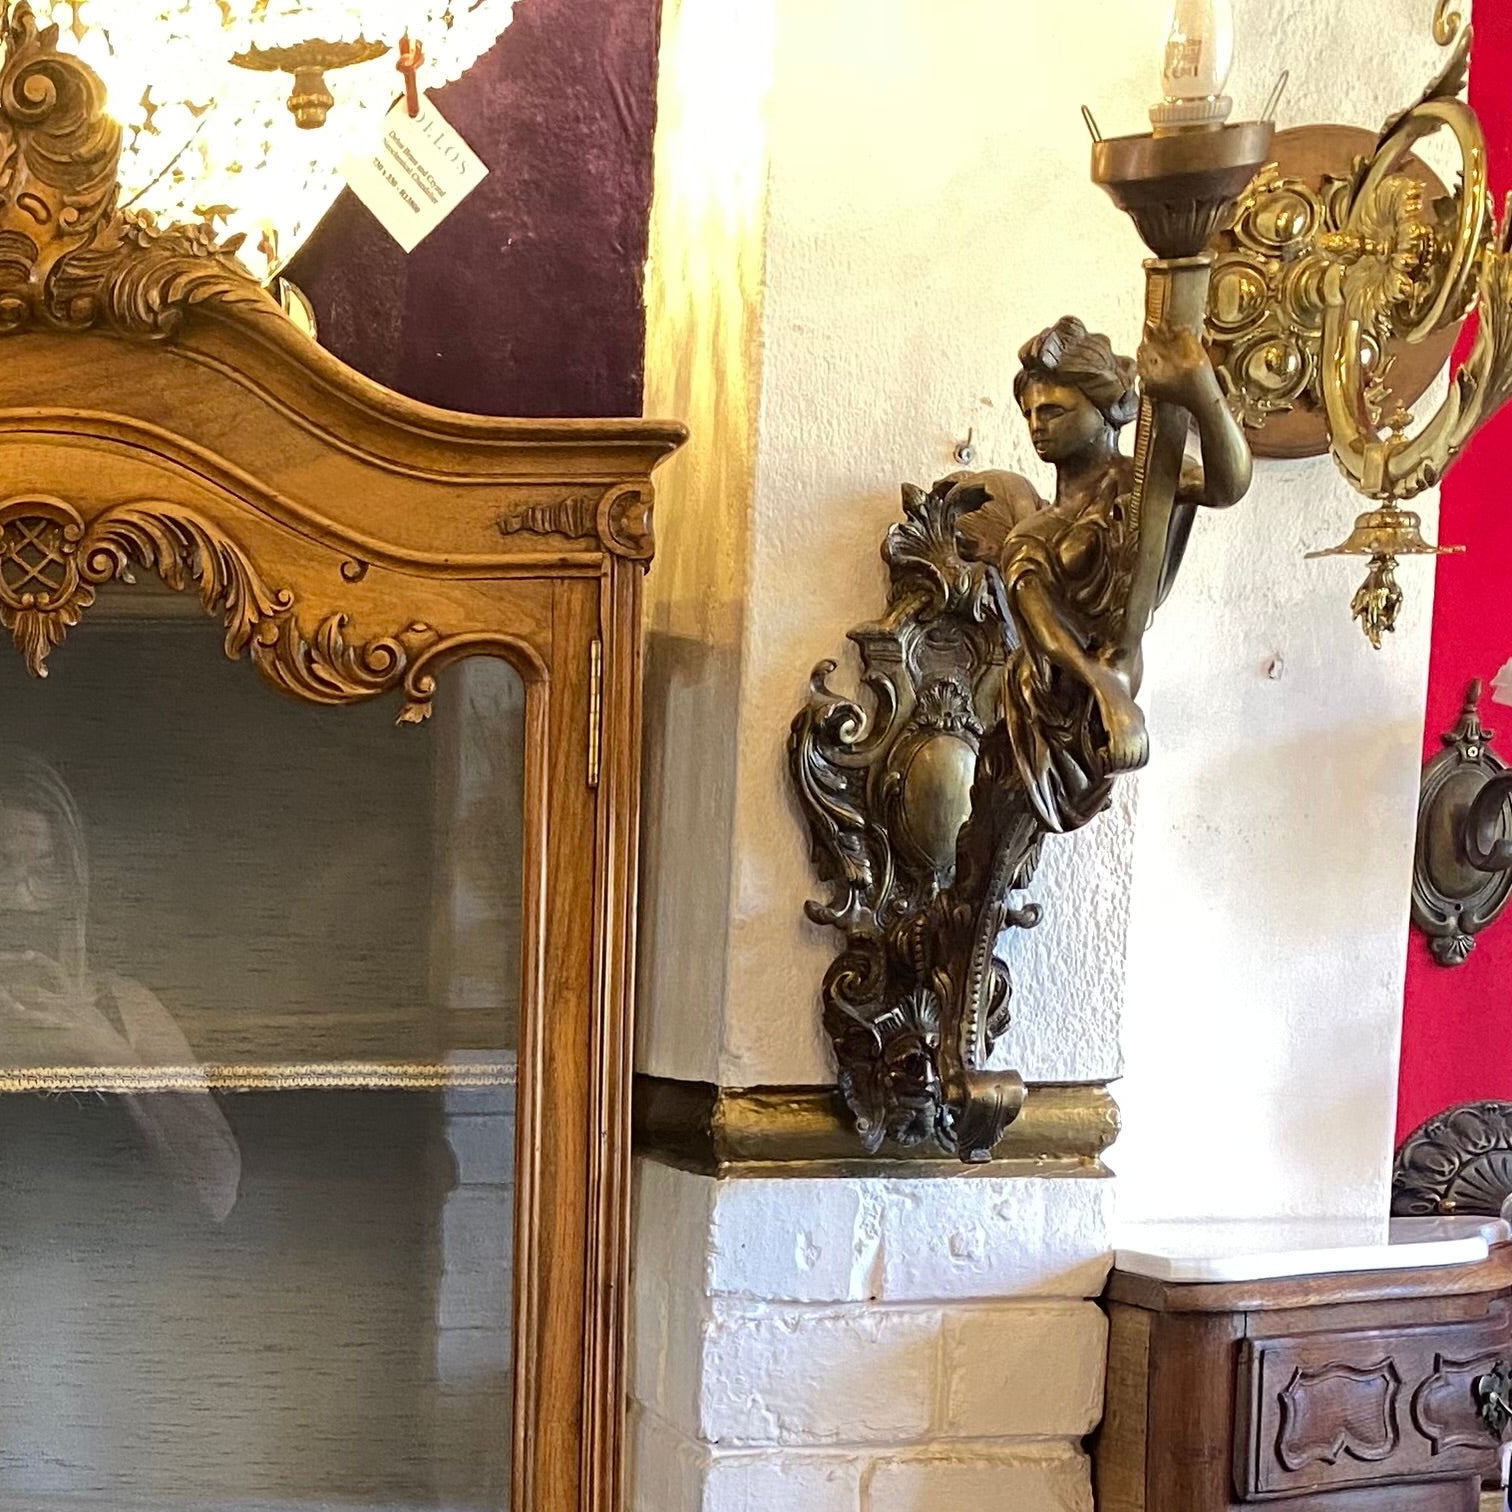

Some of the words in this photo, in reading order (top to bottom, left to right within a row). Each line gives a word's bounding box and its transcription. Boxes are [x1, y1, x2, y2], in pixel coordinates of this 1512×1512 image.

[412, 173, 439, 204] Chandelier
[416, 165, 429, 177] and
[426, 174, 446, 198] Crystal
